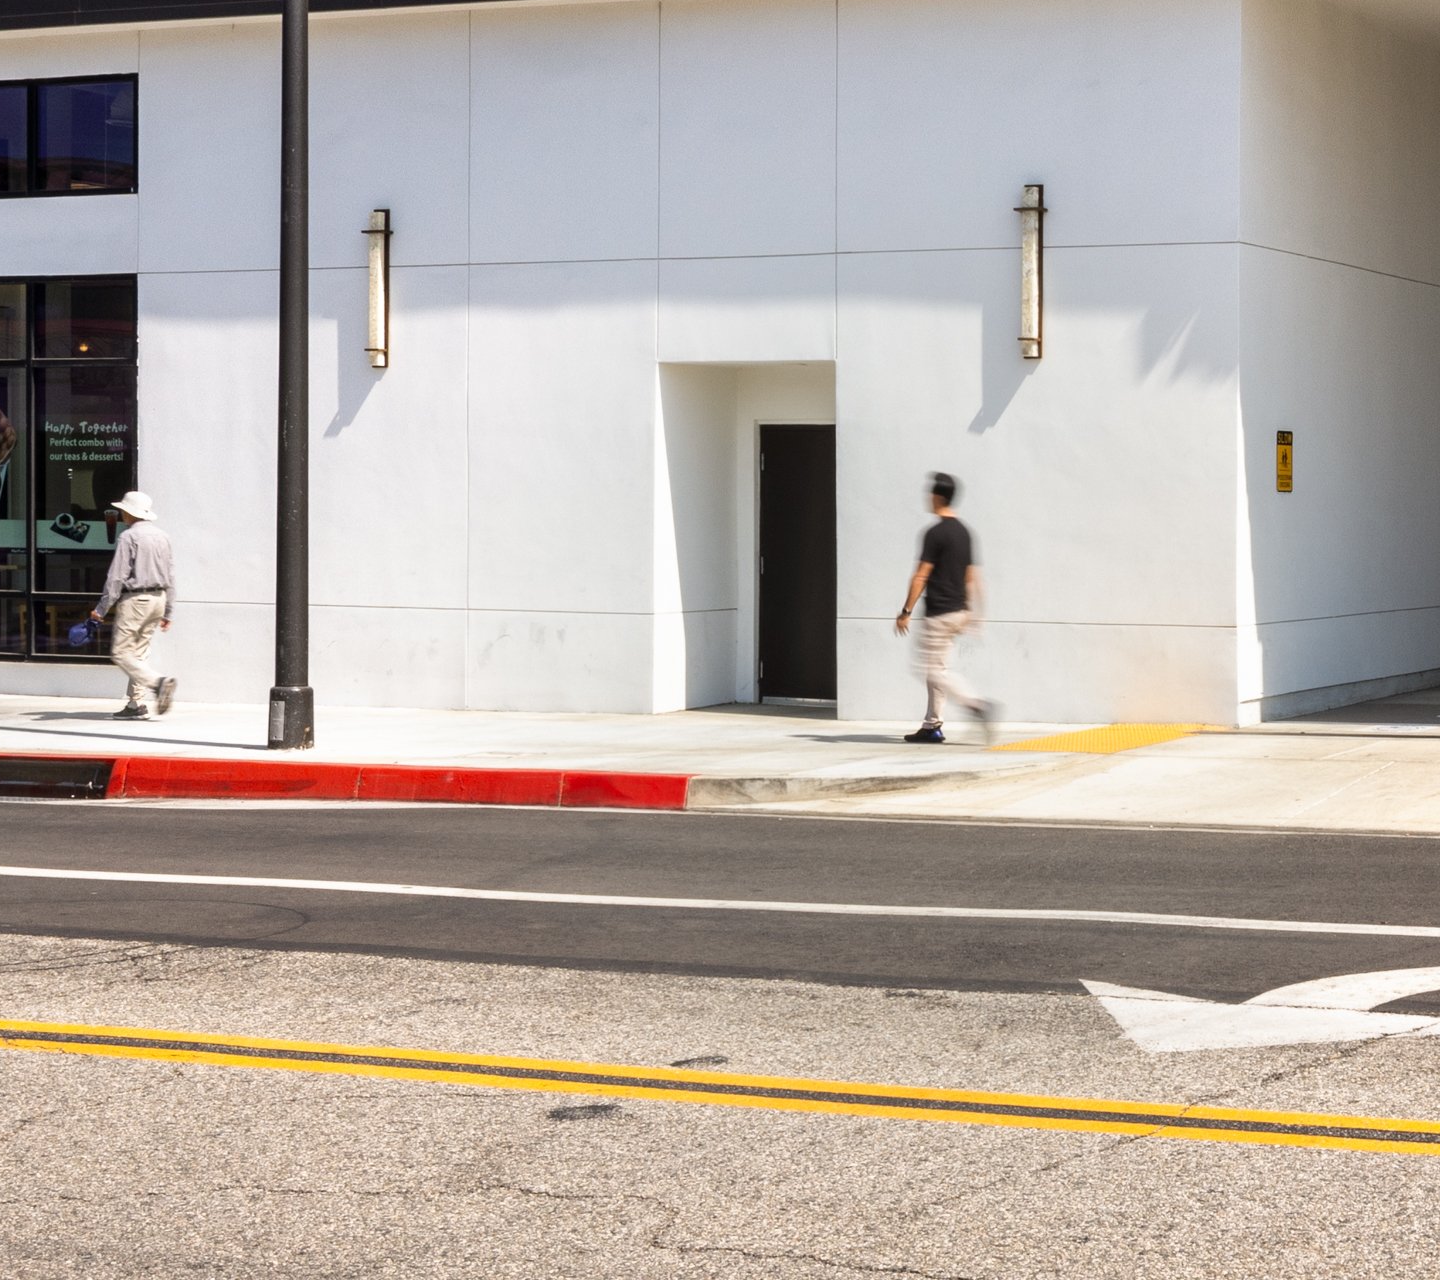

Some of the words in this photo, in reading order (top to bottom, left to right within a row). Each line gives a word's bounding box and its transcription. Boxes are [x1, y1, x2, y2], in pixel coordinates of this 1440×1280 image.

[45, 421, 74, 435] Happy
[79, 421, 128, 435] Together
[49, 438, 77, 447] Perfect
[78, 438, 104, 447] combo
[106, 438, 123, 447] with
[64, 452, 80, 460] teas
[81, 452, 88, 460] &
[89, 451, 124, 461] desserts!
